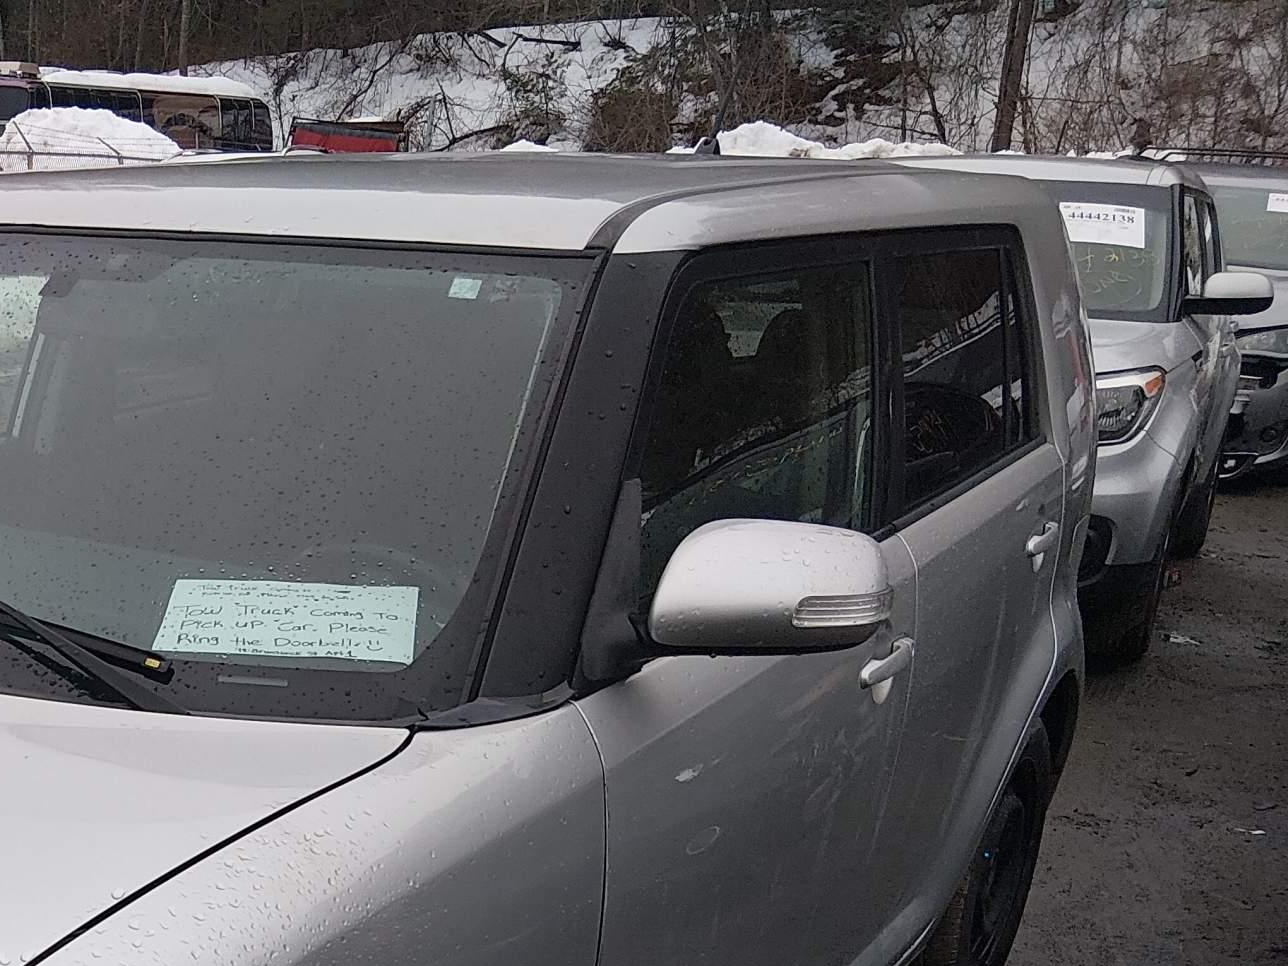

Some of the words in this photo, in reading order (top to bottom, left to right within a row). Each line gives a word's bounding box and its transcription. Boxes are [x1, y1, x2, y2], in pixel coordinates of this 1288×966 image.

[1068, 211, 1135, 224] 44442138
[329, 622, 389, 634] Please
[177, 633, 220, 645] Ring
[230, 636, 263, 646] the
